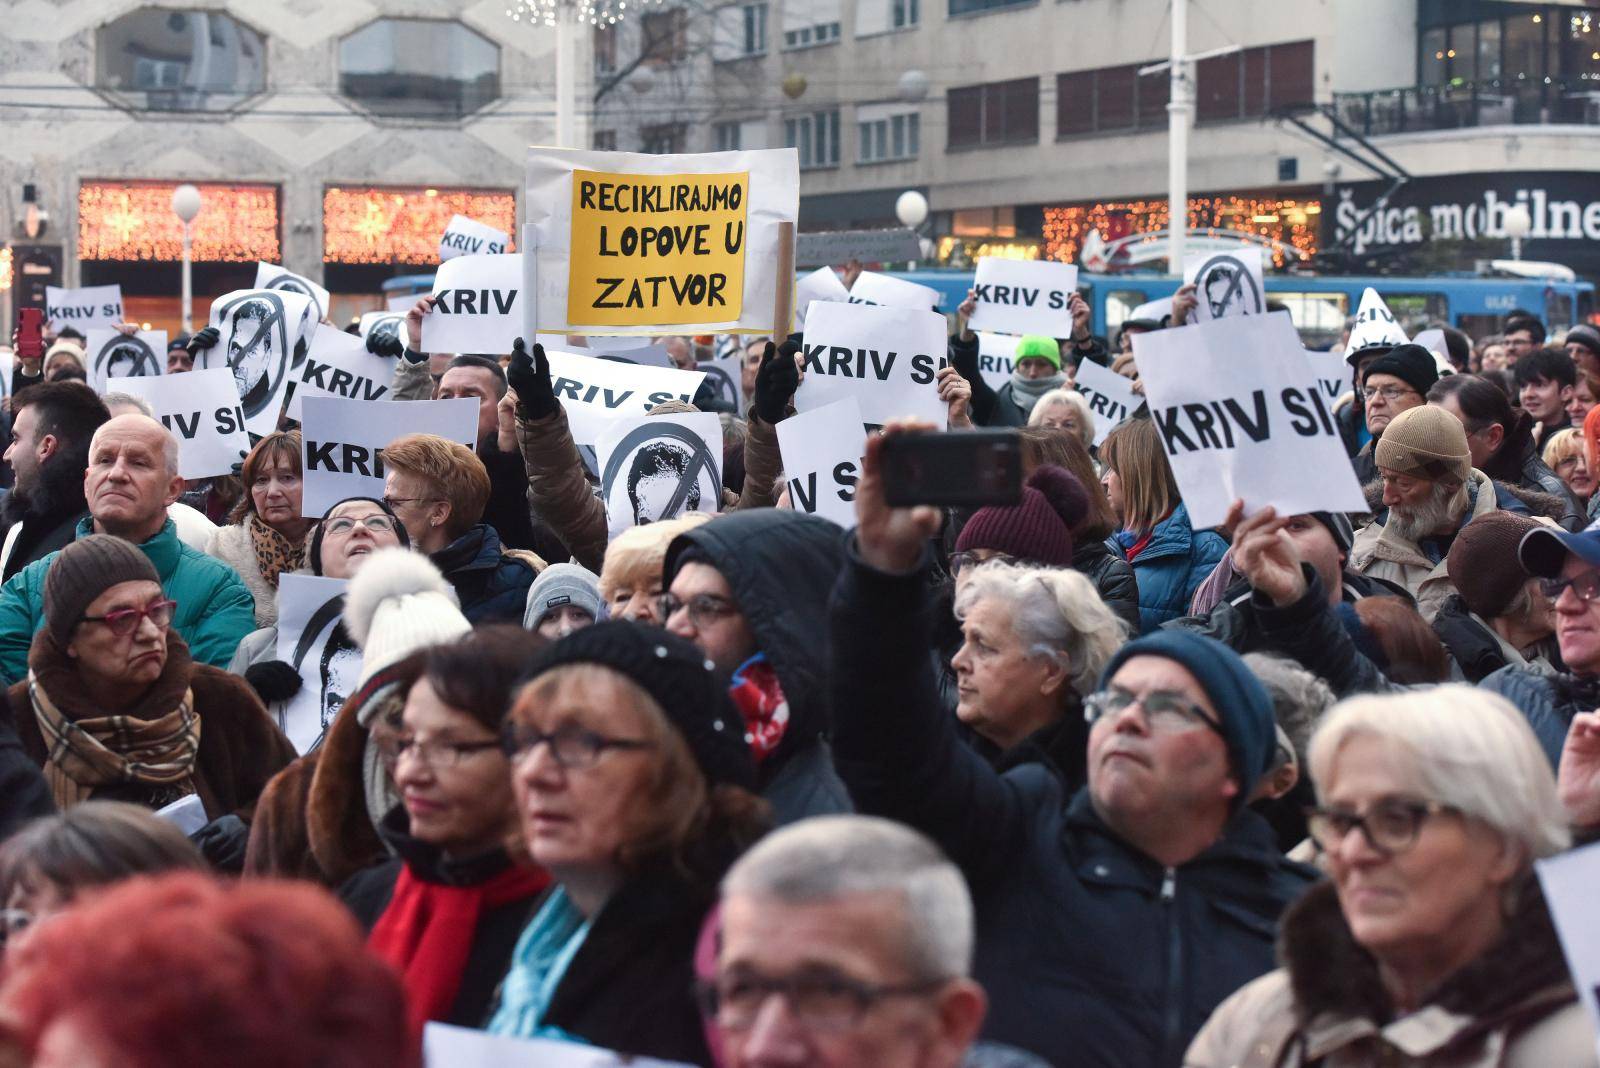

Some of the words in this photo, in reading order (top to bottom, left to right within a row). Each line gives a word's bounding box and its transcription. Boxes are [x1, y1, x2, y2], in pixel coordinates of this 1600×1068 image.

[580, 181, 742, 213] RECIKLIRAJMO
[599, 225, 710, 257] LOPOVE
[725, 221, 743, 255] U
[1335, 188, 1423, 255] Špica
[441, 231, 483, 253] KRIV
[432, 289, 518, 315] KRIV
[592, 273, 727, 309] ZATVOR
[974, 284, 1040, 307] KRIV
[48, 306, 95, 319] KRIV
[103, 303, 120, 316] SI
[301, 358, 389, 400] KRIV
[802, 343, 897, 381] KRIV
[551, 375, 635, 408] RIV
[162, 411, 201, 439] IV
[214, 406, 245, 435] SI
[1153, 390, 1270, 456] KRIV
[1281, 387, 1335, 437] SI
[306, 440, 385, 479] KRI
[832, 455, 865, 502] S
